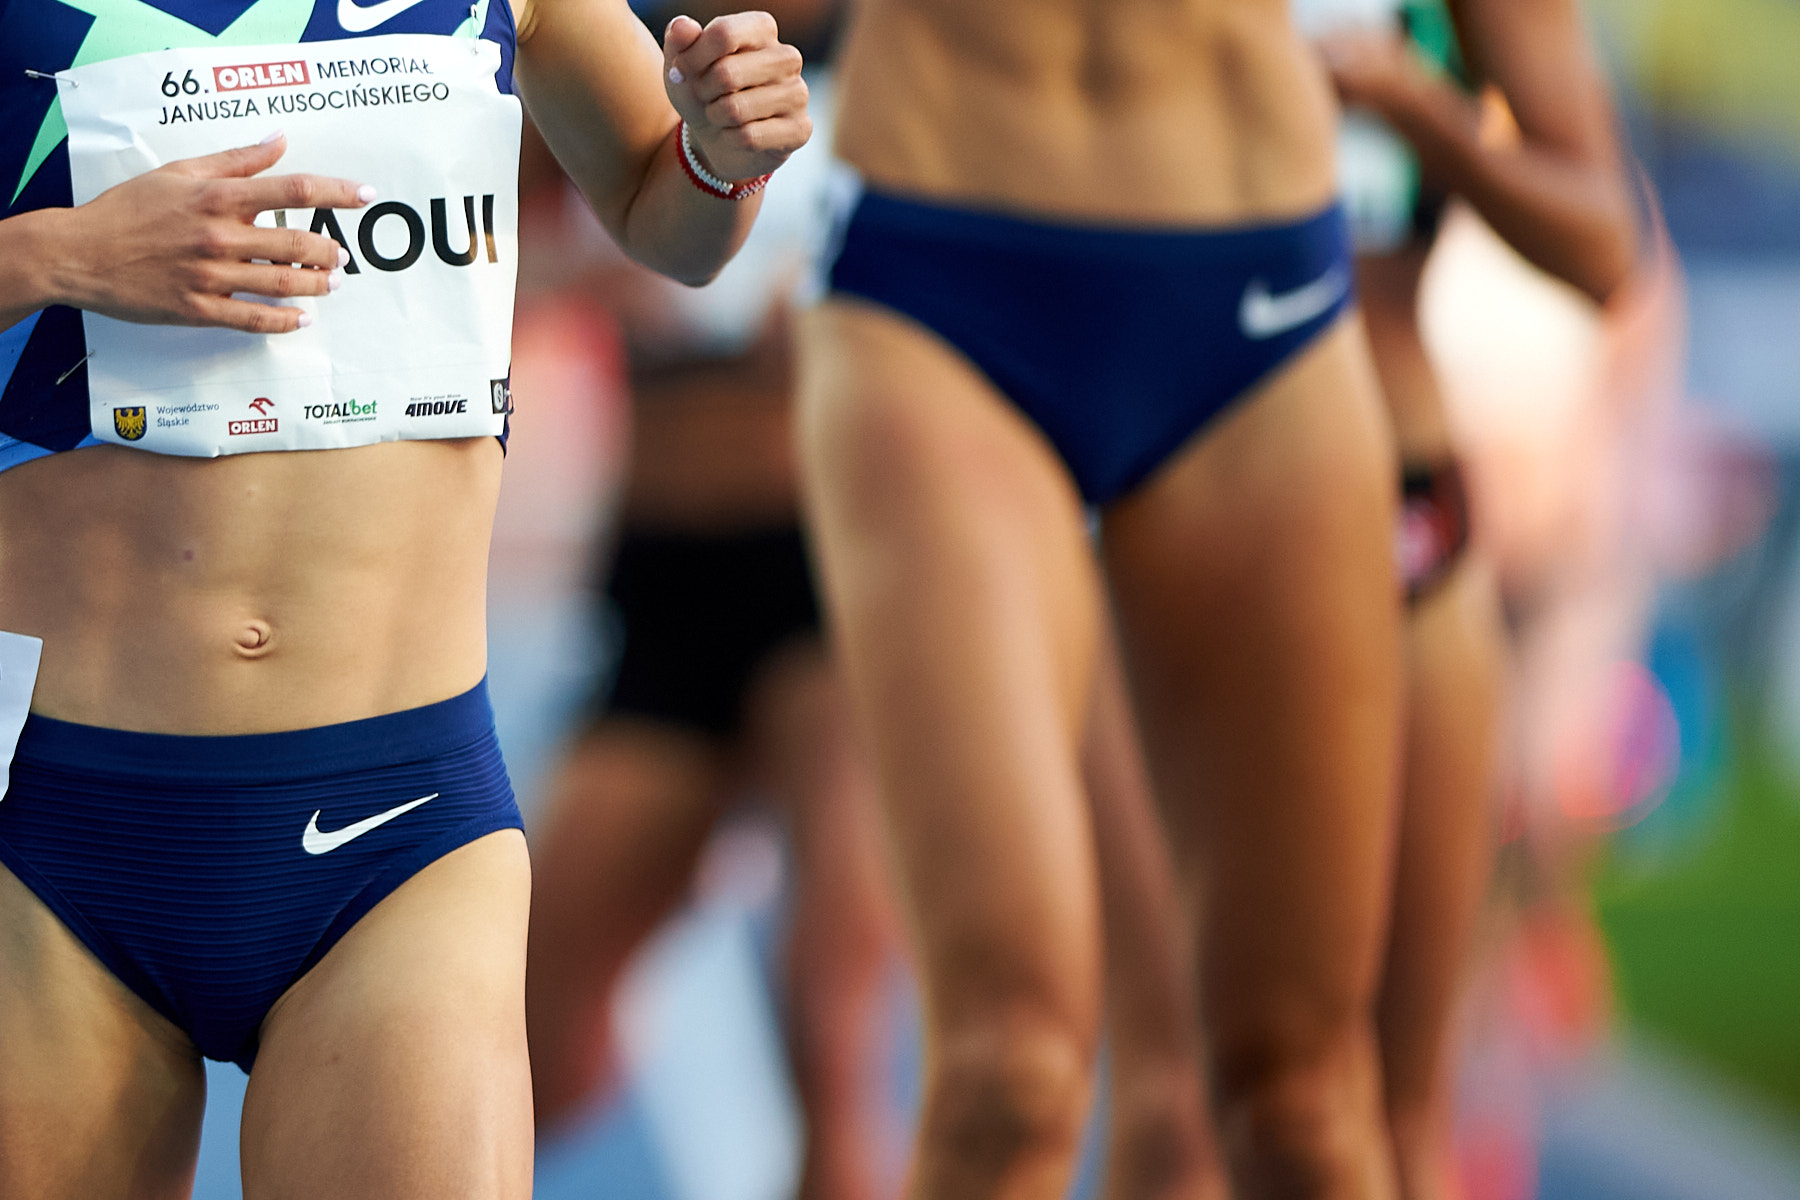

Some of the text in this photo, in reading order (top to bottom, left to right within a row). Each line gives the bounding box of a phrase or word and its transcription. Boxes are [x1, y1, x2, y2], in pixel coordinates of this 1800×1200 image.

[161, 57, 434, 98] 66. ORLEN MEMORIAŁ
[159, 82, 449, 125] JANUSZA KUSOCIŃSKIEGO
[274, 194, 498, 275] AOUI
[156, 403, 220, 415] Województwo
[304, 398, 378, 420] TOTALbet
[405, 399, 468, 417] 4MOVE
[156, 416, 190, 428] Śląskie
[230, 419, 276, 434] ORLEN
